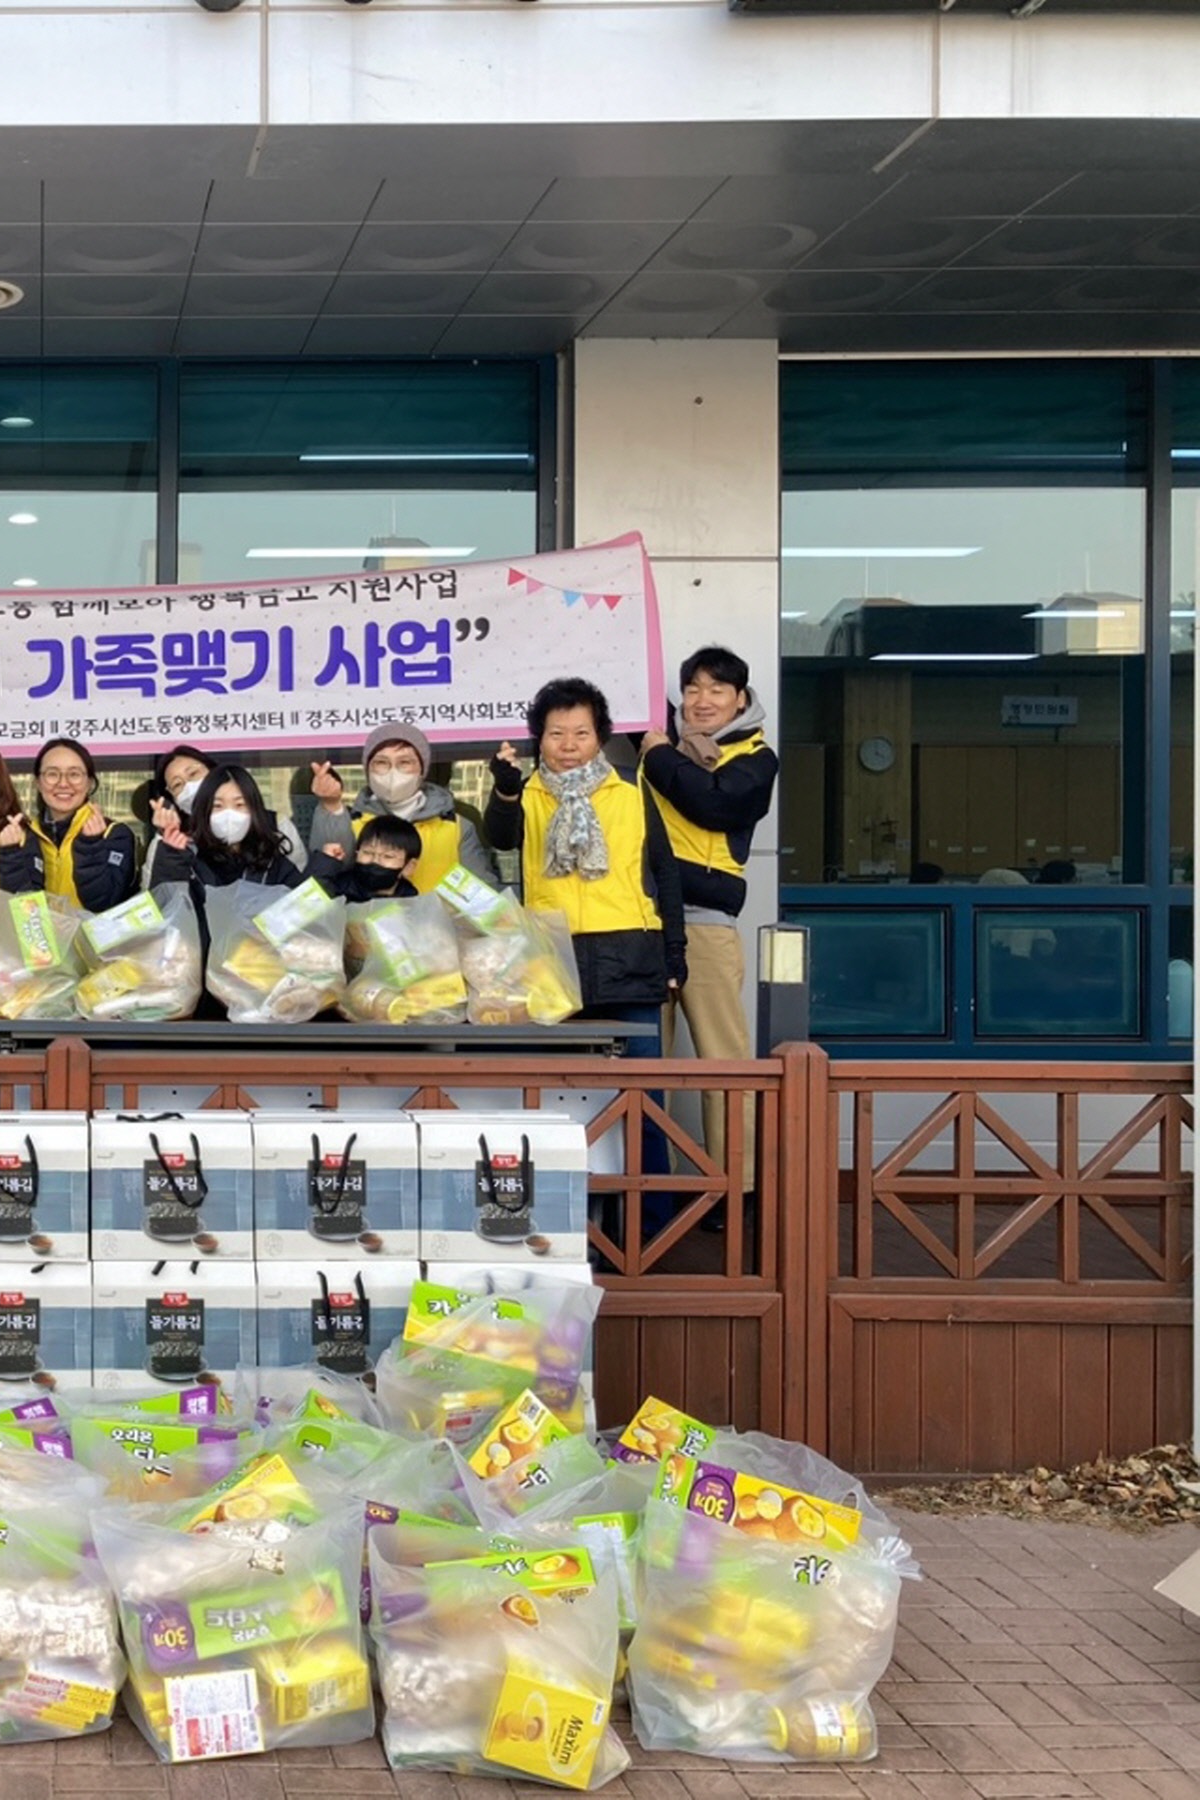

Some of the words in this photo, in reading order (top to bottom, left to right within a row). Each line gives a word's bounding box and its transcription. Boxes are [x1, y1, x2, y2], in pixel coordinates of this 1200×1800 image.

[329, 569, 458, 603] 지원사업
[26, 626, 294, 699] 가족맺기
[557, 1714, 585, 1766] Maxim
